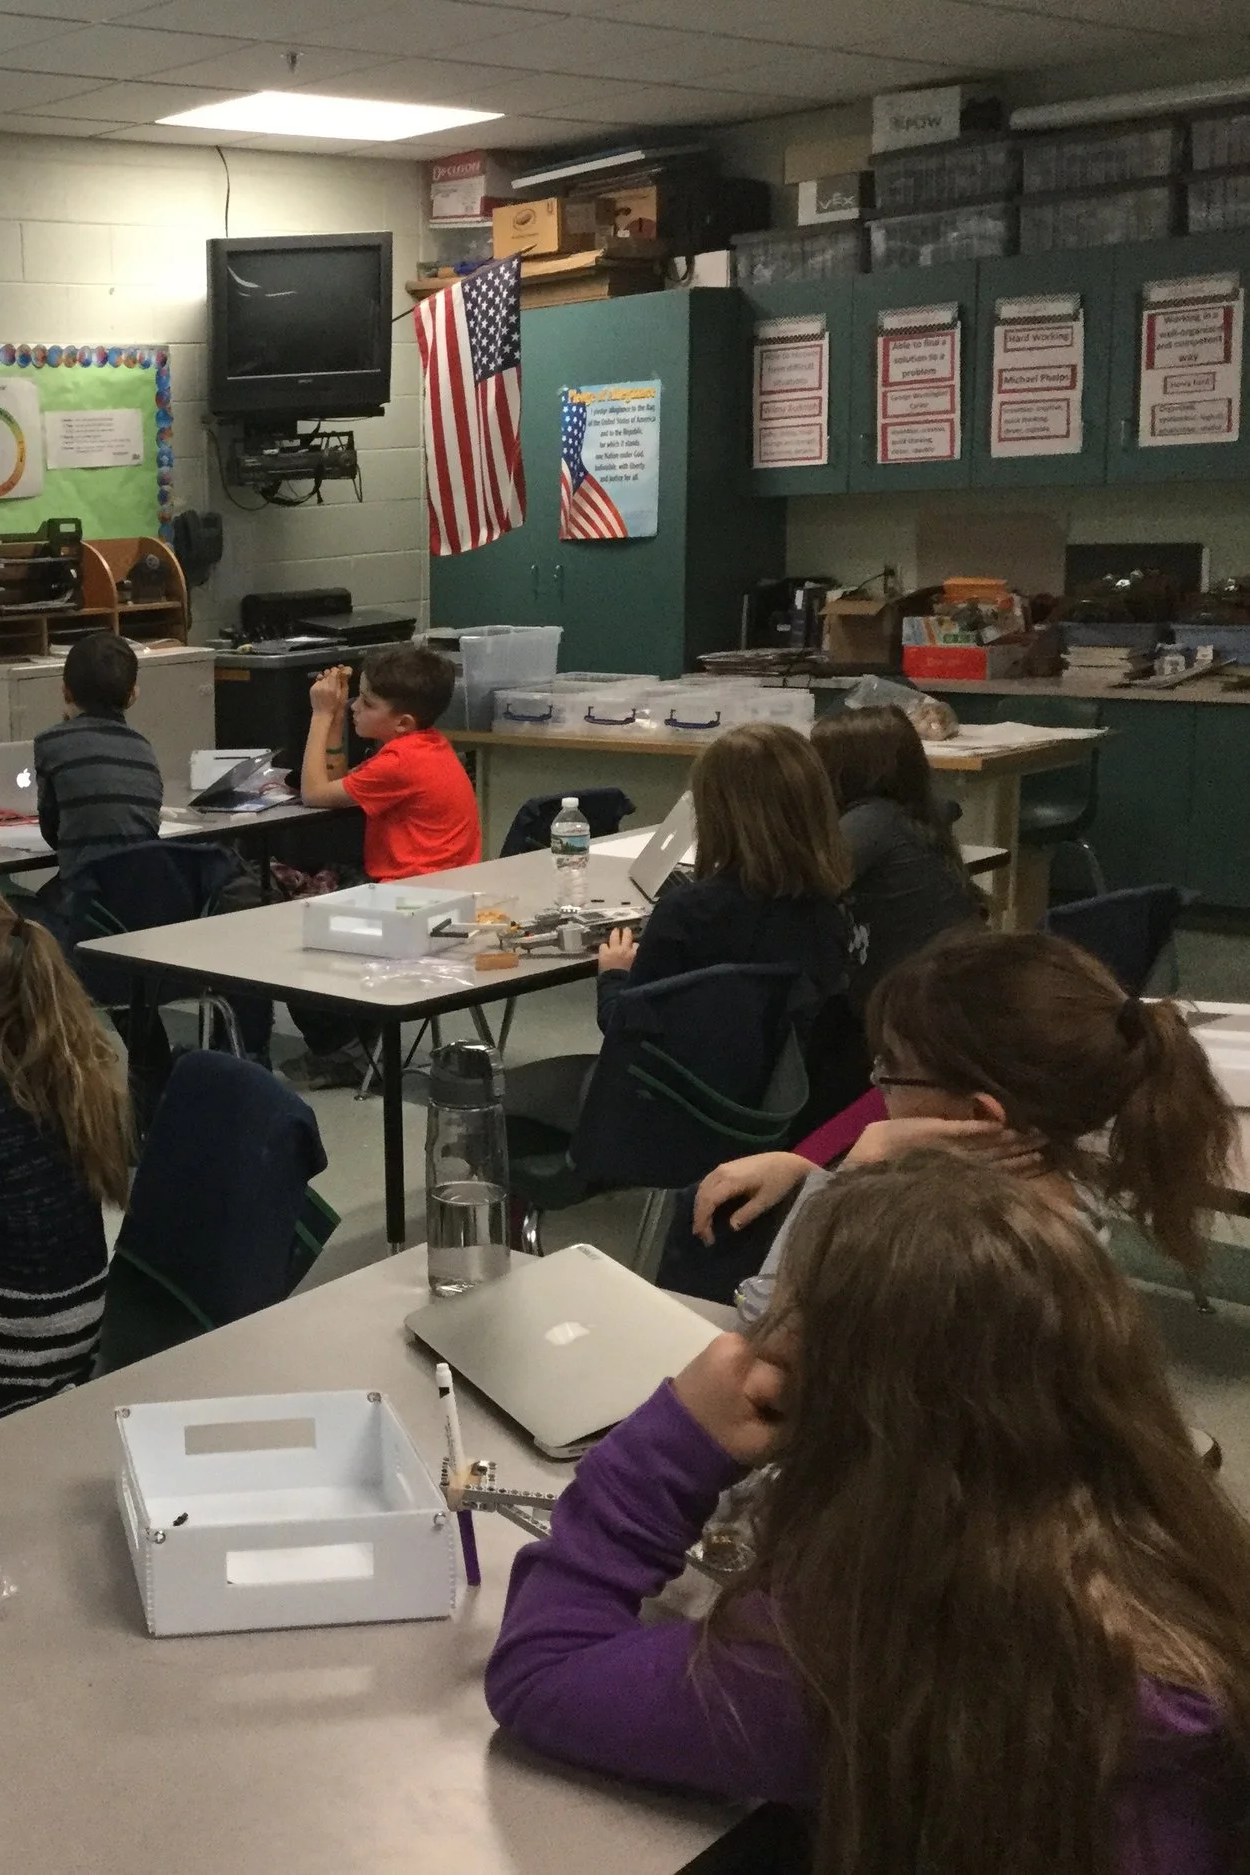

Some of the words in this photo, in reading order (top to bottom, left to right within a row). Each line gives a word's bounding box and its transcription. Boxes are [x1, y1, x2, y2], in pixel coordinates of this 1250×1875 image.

[1164, 314, 1200, 324] Working
[1009, 333, 1029, 343] Hard
[1033, 332, 1069, 343] Working
[1156, 341, 1172, 350] and
[1174, 335, 1222, 349] competent
[894, 355, 927, 364] solution
[902, 367, 937, 379] problem
[1004, 374, 1038, 385] Michael
[1040, 372, 1069, 384] Phelps
